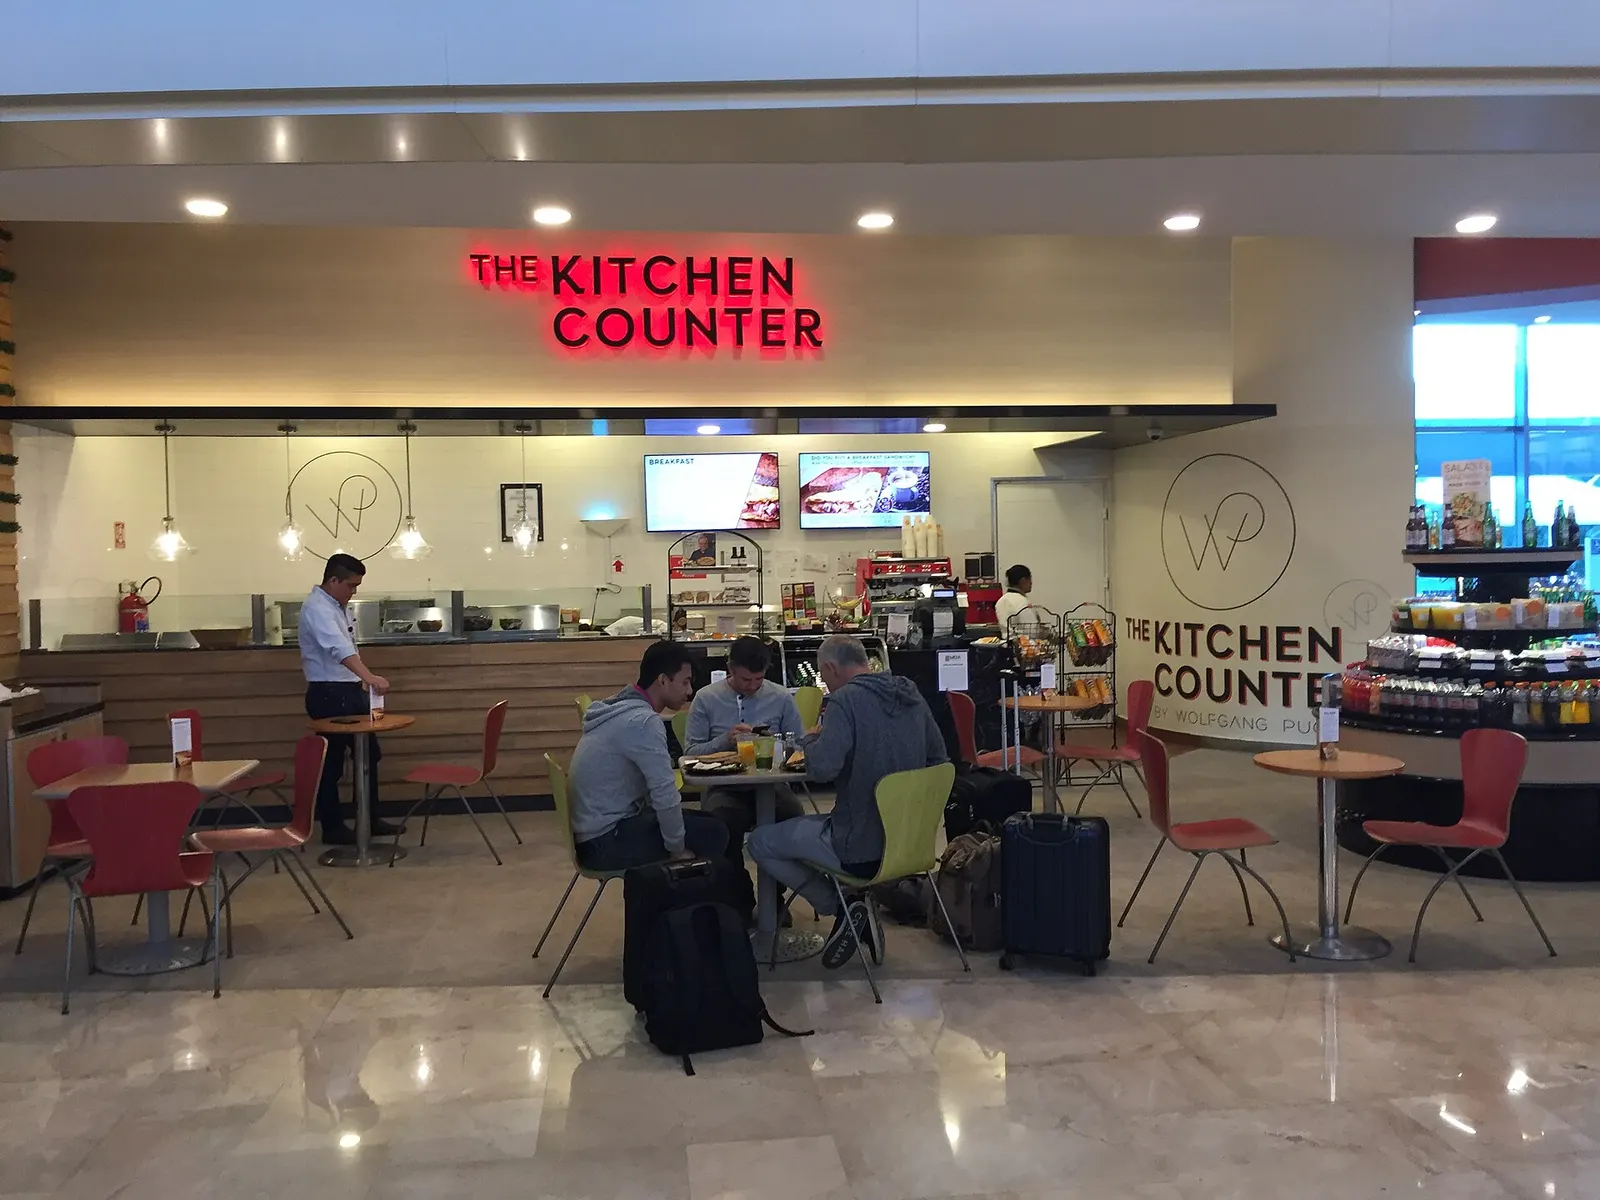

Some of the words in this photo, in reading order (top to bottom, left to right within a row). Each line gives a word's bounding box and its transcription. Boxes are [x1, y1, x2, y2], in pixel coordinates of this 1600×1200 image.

[470, 254, 538, 282] THE
[551, 255, 794, 296] KITCHEN
[553, 307, 824, 348] COUNTER
[649, 458, 695, 466] BREAKFAST
[1125, 617, 1150, 642] THE
[1154, 620, 1342, 664] KITCHEN
[1154, 662, 1323, 708] COUNTE
[1154, 706, 1168, 719] BY
[1176, 710, 1268, 732] WOLFGANG
